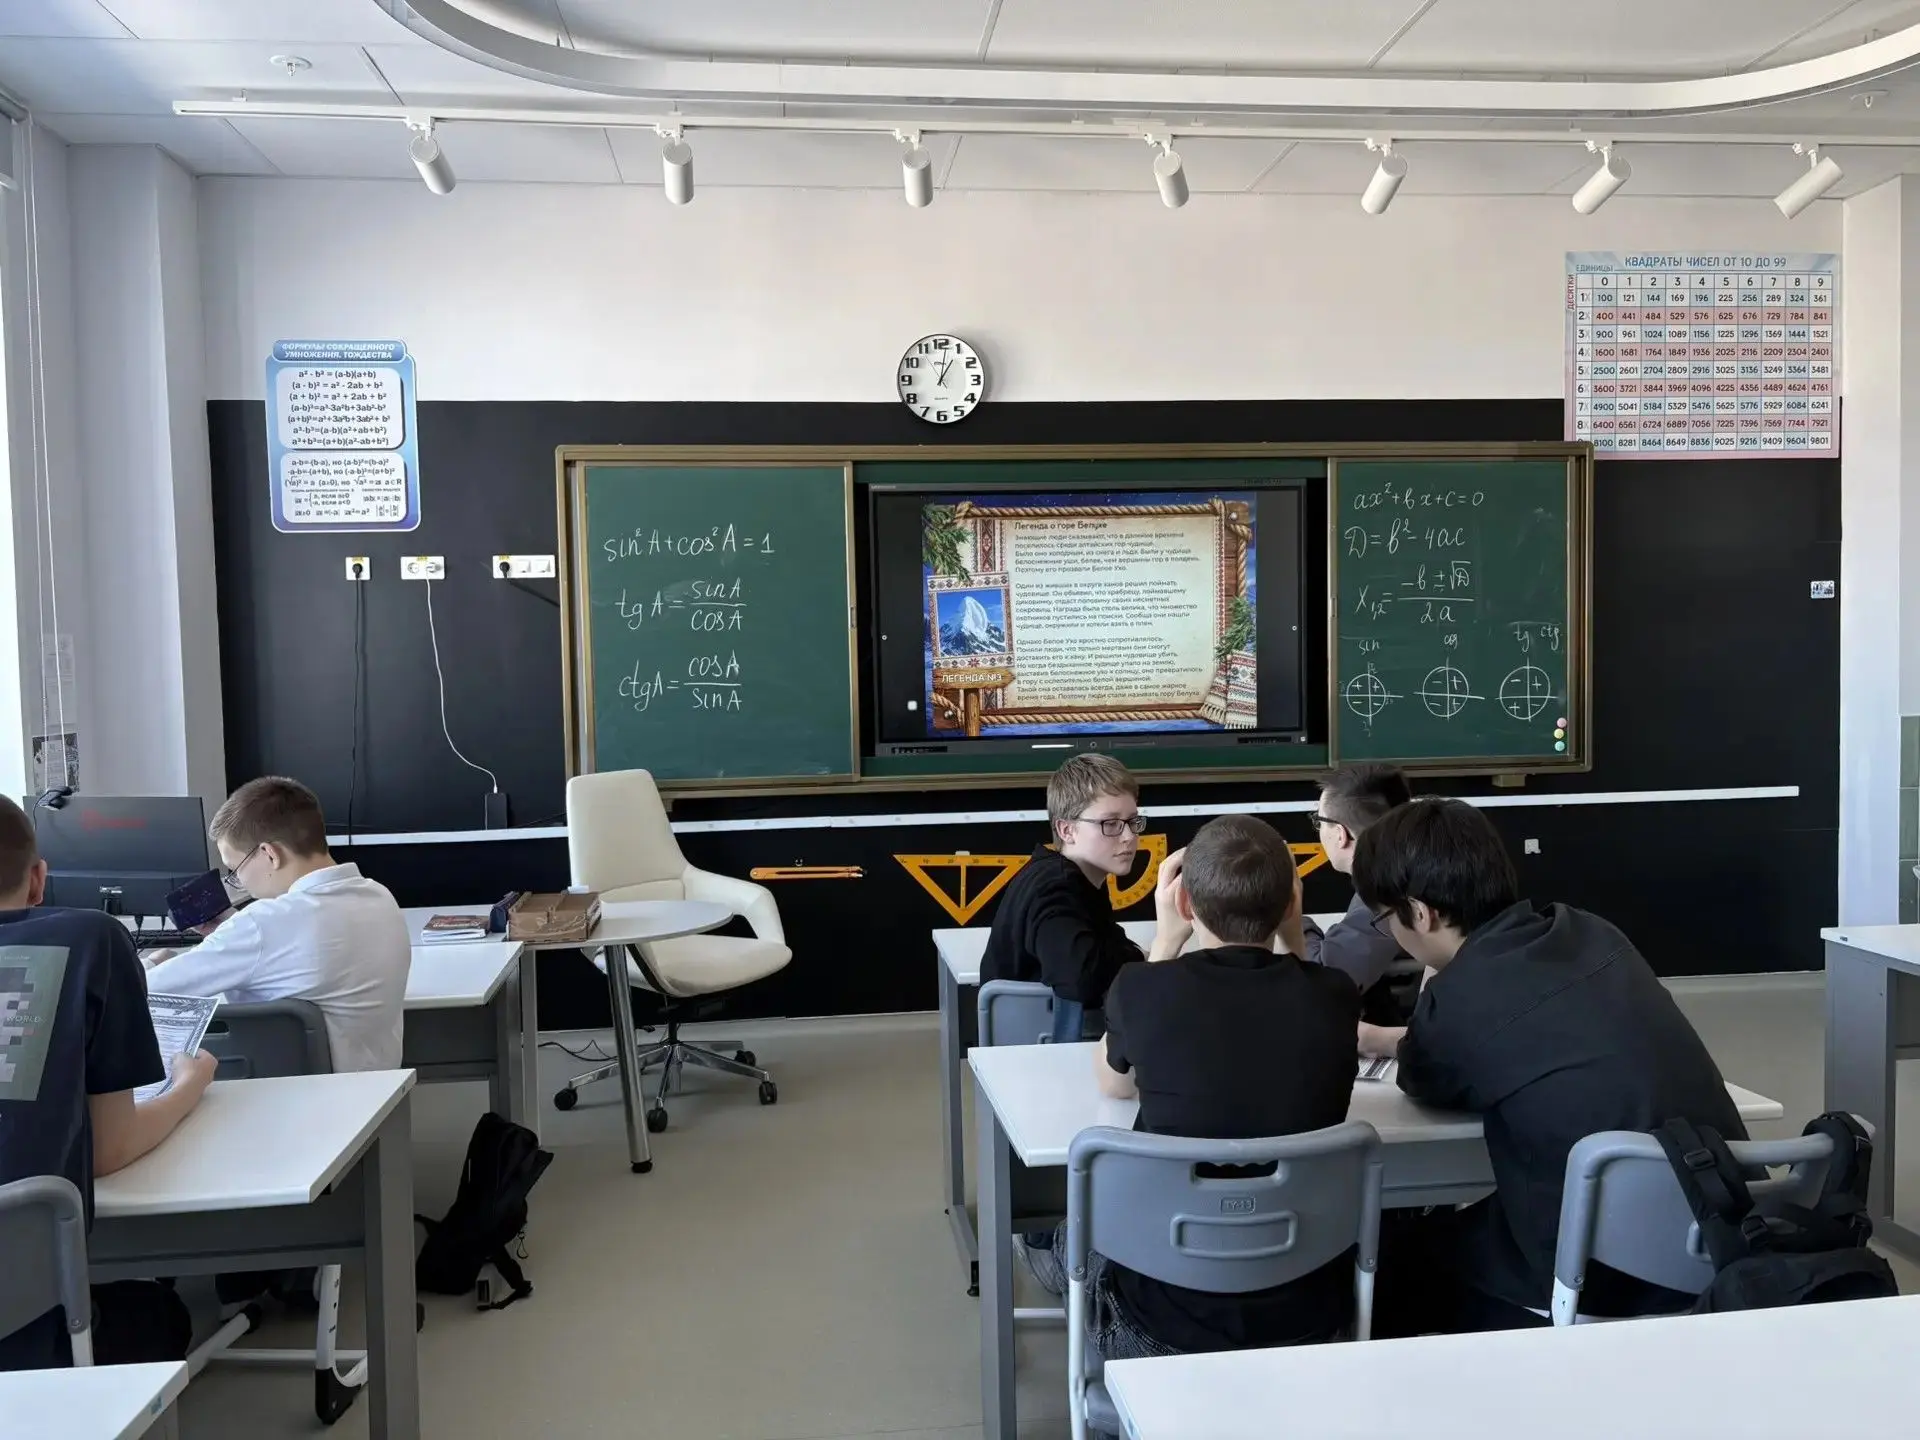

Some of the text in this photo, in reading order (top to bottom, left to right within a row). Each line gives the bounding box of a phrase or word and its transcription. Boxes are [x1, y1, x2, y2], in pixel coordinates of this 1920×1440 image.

[1625, 256, 1786, 268] КВАДРАТЫ ЧИСЕЛ ОТ 10 ДО 99
[1576, 264, 1613, 272] ЕДИНИЦЫ
[1601, 276, 1825, 287] 0 1 2 3 4 5 6 7 8 9
[1598, 293, 1613, 302] 100
[1623, 294, 1635, 302] 121
[1647, 294, 1661, 302] 144
[1671, 293, 1685, 302] 169
[1695, 294, 1709, 302] 196
[1718, 294, 1734, 302] 225
[1742, 294, 1758, 302] 256
[1766, 294, 1782, 302] 289
[1789, 294, 1805, 303] 324
[1813, 294, 1827, 303] 361
[1596, 312, 1614, 320] 400
[1621, 312, 1636, 320] 441
[1645, 312, 1661, 321] 484
[1669, 312, 1685, 321] 529
[1694, 311, 1709, 320] 576
[1718, 312, 1734, 320] 625
[1742, 312, 1758, 320] 676
[1767, 312, 1781, 321] 729
[1790, 312, 1805, 321] 784
[1813, 312, 1827, 321] 841
[918, 344, 929, 354] 11
[932, 338, 950, 350] 12
[955, 343, 961, 354] 1
[905, 358, 919, 368] 10
[965, 357, 977, 368] 2
[1593, 366, 1616, 375] 2500
[1619, 366, 1639, 375] 2601
[1643, 366, 1663, 375] 2704
[1667, 366, 1688, 375] 2809
[1692, 366, 1711, 375] 2916
[1715, 365, 1736, 374] 3025
[1740, 365, 1759, 374] 3136
[1763, 365, 1783, 374] 3249
[1787, 365, 1807, 374] 3364
[1811, 365, 1829, 374] 3481
[901, 375, 912, 386] 9
[970, 374, 981, 386] 3
[906, 393, 918, 404] 8
[964, 393, 976, 403] 4
[920, 406, 930, 417] 7
[936, 411, 947, 422] 6
[954, 405, 965, 417] 5
[1592, 421, 1615, 429] 6400
[1618, 420, 1637, 429] 6561
[1642, 420, 1662, 429] 6724
[1666, 420, 1688, 429] 6889
[1691, 419, 1711, 429] 7056
[1716, 419, 1735, 428] 7225
[1739, 419, 1759, 428] 7396
[1764, 419, 1783, 428] 7569
[1788, 419, 1805, 427] 7744
[1812, 419, 1828, 427] 7921
[1014, 522, 1048, 530] Легенда
[1077, 521, 1107, 530] Белухе
[942, 674, 984, 683] ЛЕГЕНДА
